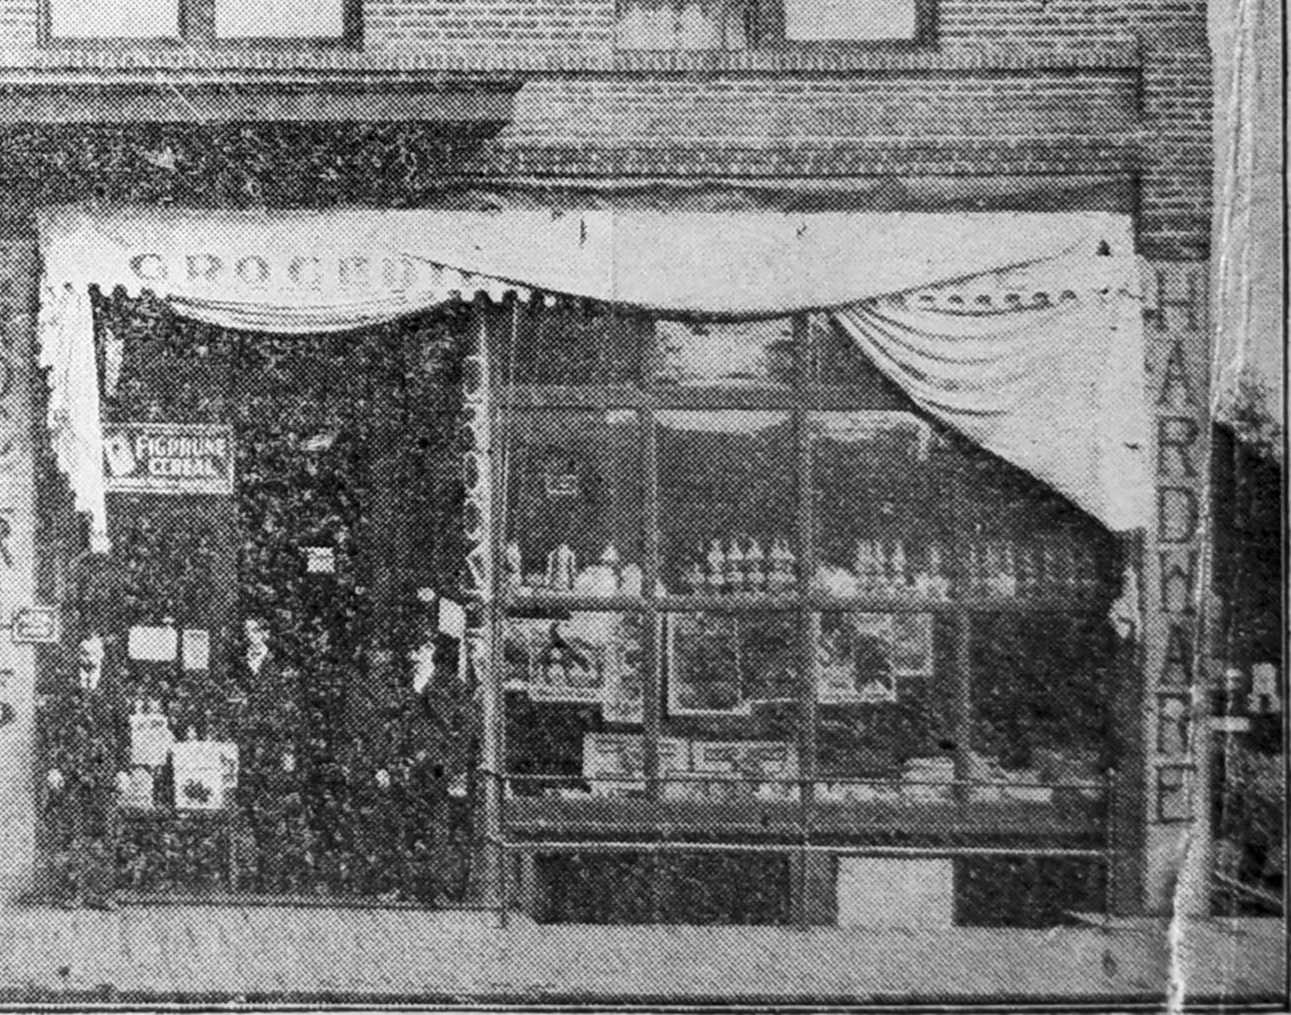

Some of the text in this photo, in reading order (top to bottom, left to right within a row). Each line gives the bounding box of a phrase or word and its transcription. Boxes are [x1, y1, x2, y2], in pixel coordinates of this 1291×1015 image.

[135, 435, 227, 459] FIGPRUNE
[148, 457, 217, 476] CEREAL
[1158, 264, 1200, 824] HARDWARE
